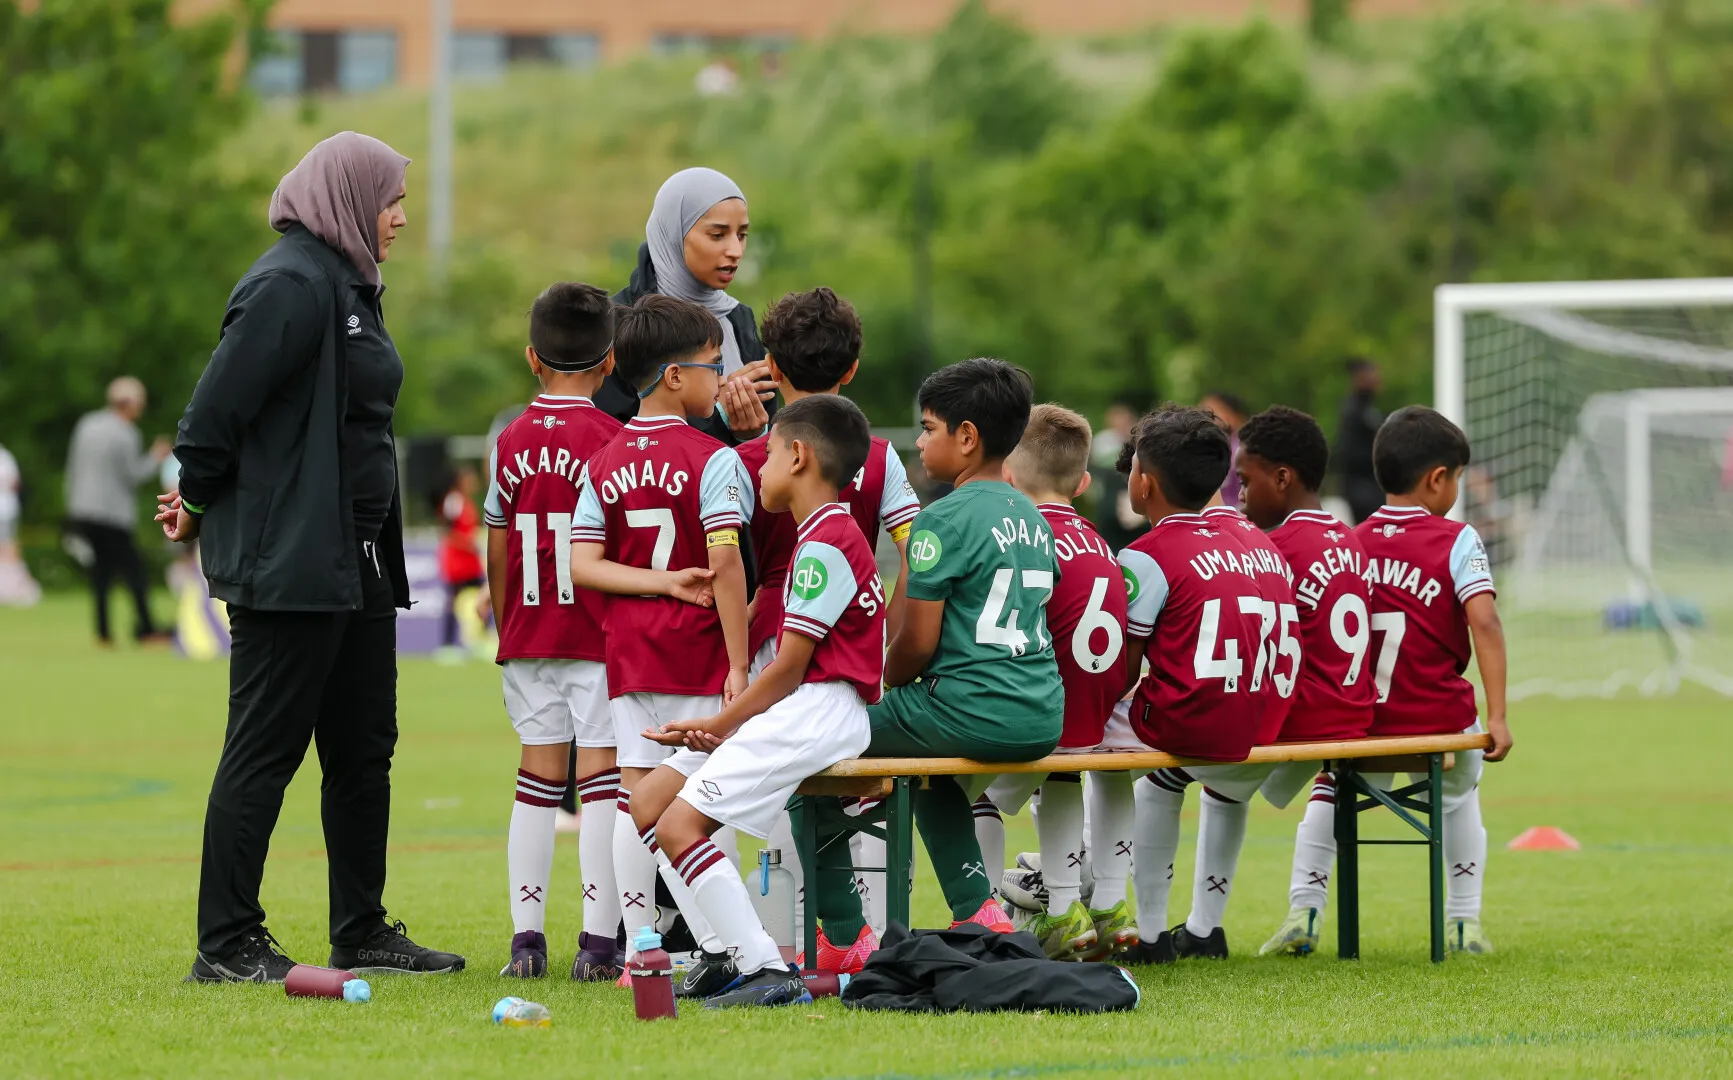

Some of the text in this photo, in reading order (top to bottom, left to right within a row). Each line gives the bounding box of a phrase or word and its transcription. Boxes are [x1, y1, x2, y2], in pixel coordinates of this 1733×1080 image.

[601, 459, 689, 504] OWAIS
[515, 512, 575, 606] 11
[625, 508, 676, 598] 7
[991, 516, 1049, 555] ADAM
[975, 568, 1054, 659] 47
[1071, 577, 1123, 674] 6
[1329, 593, 1370, 686] 9
